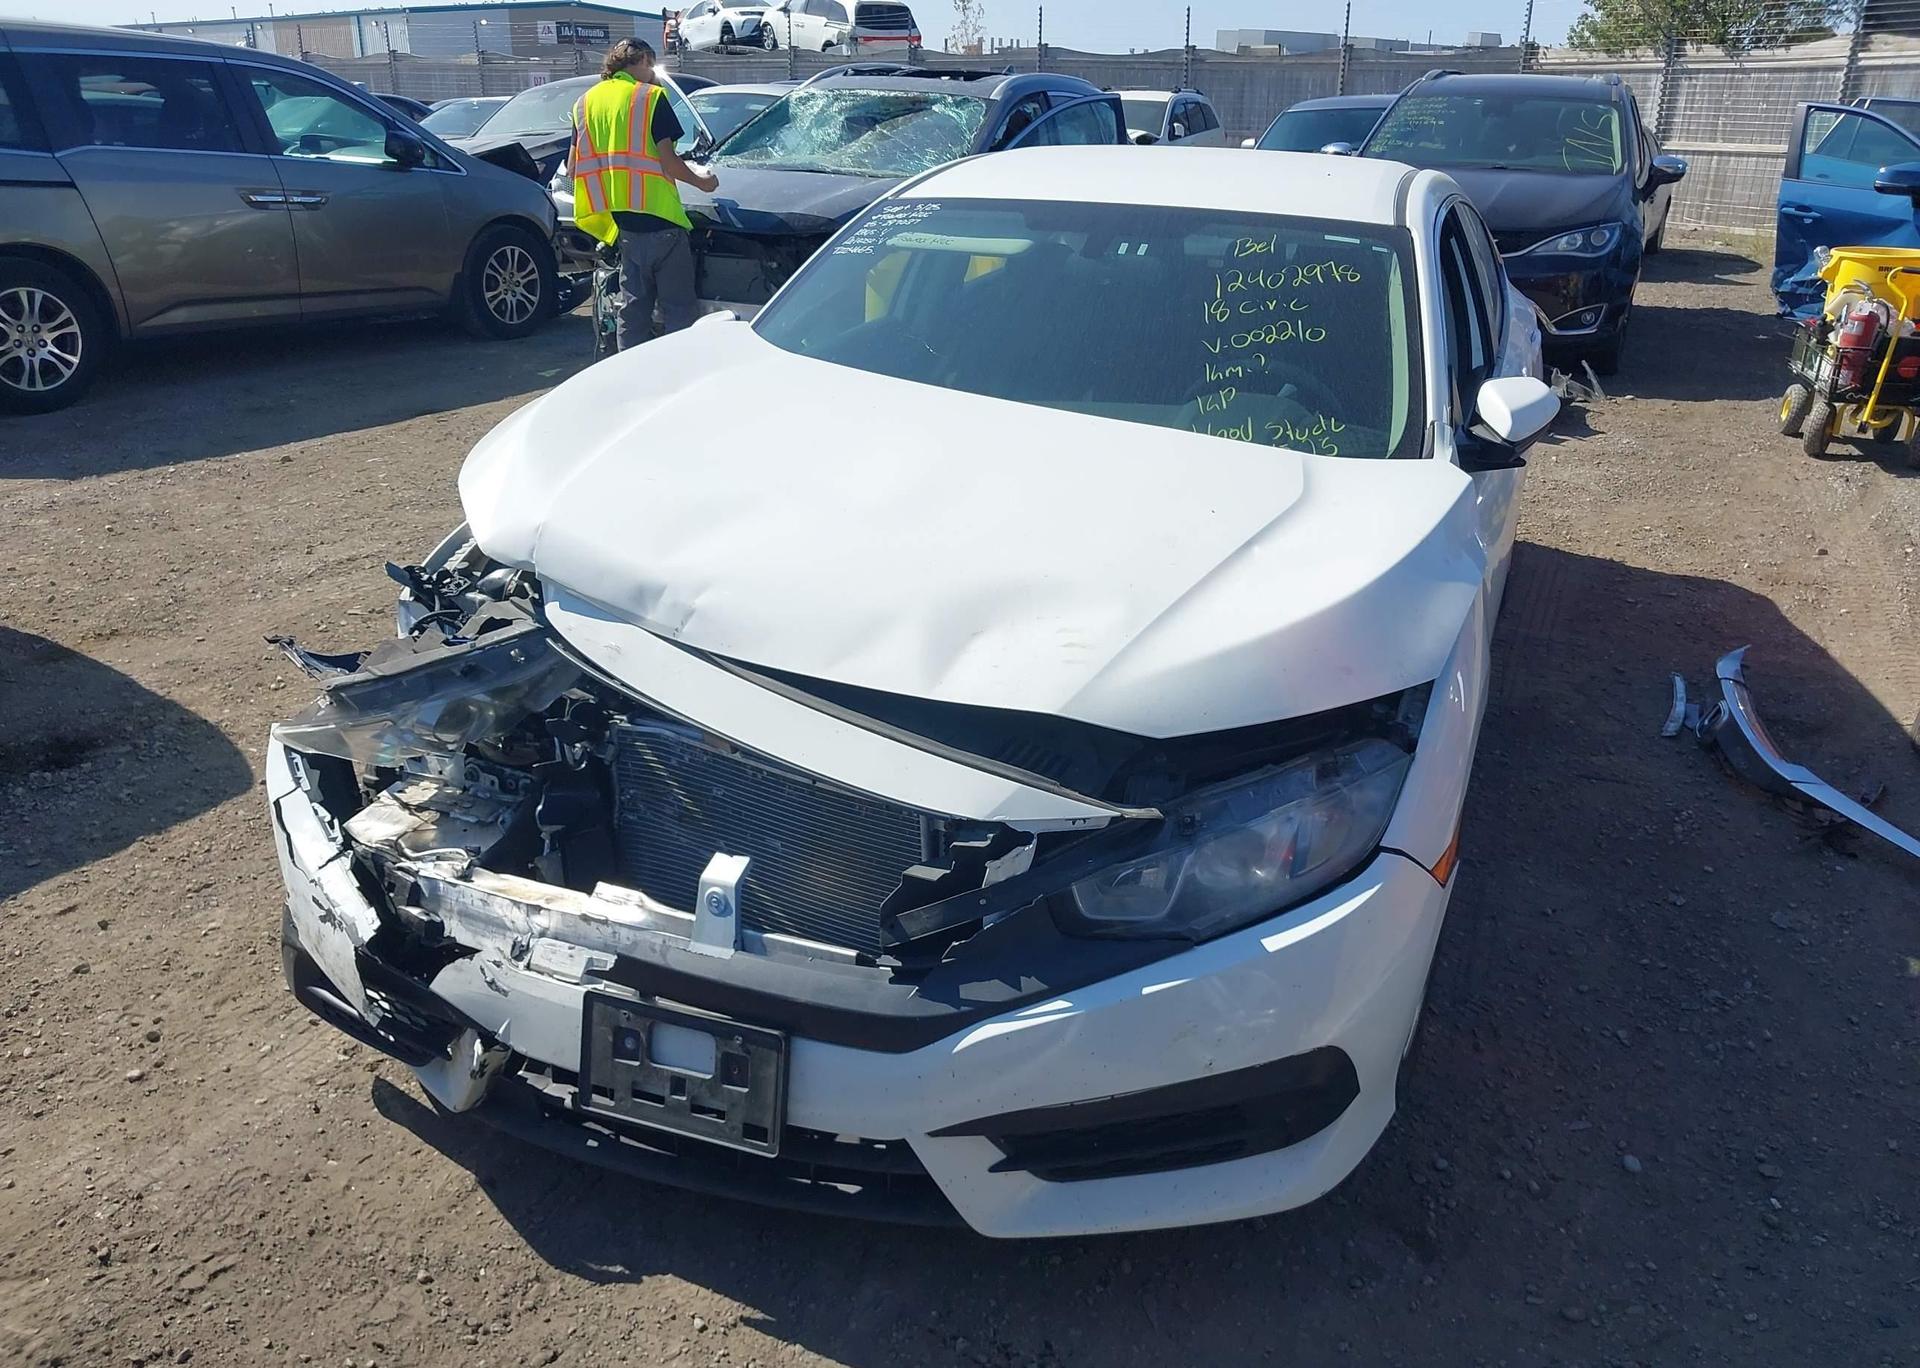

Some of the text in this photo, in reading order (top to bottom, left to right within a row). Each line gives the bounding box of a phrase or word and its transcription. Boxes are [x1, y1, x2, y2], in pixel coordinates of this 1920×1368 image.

[1233, 233, 1277, 257] Bel
[1215, 260, 1361, 299] 12402978
[1204, 298, 1230, 324] 18
